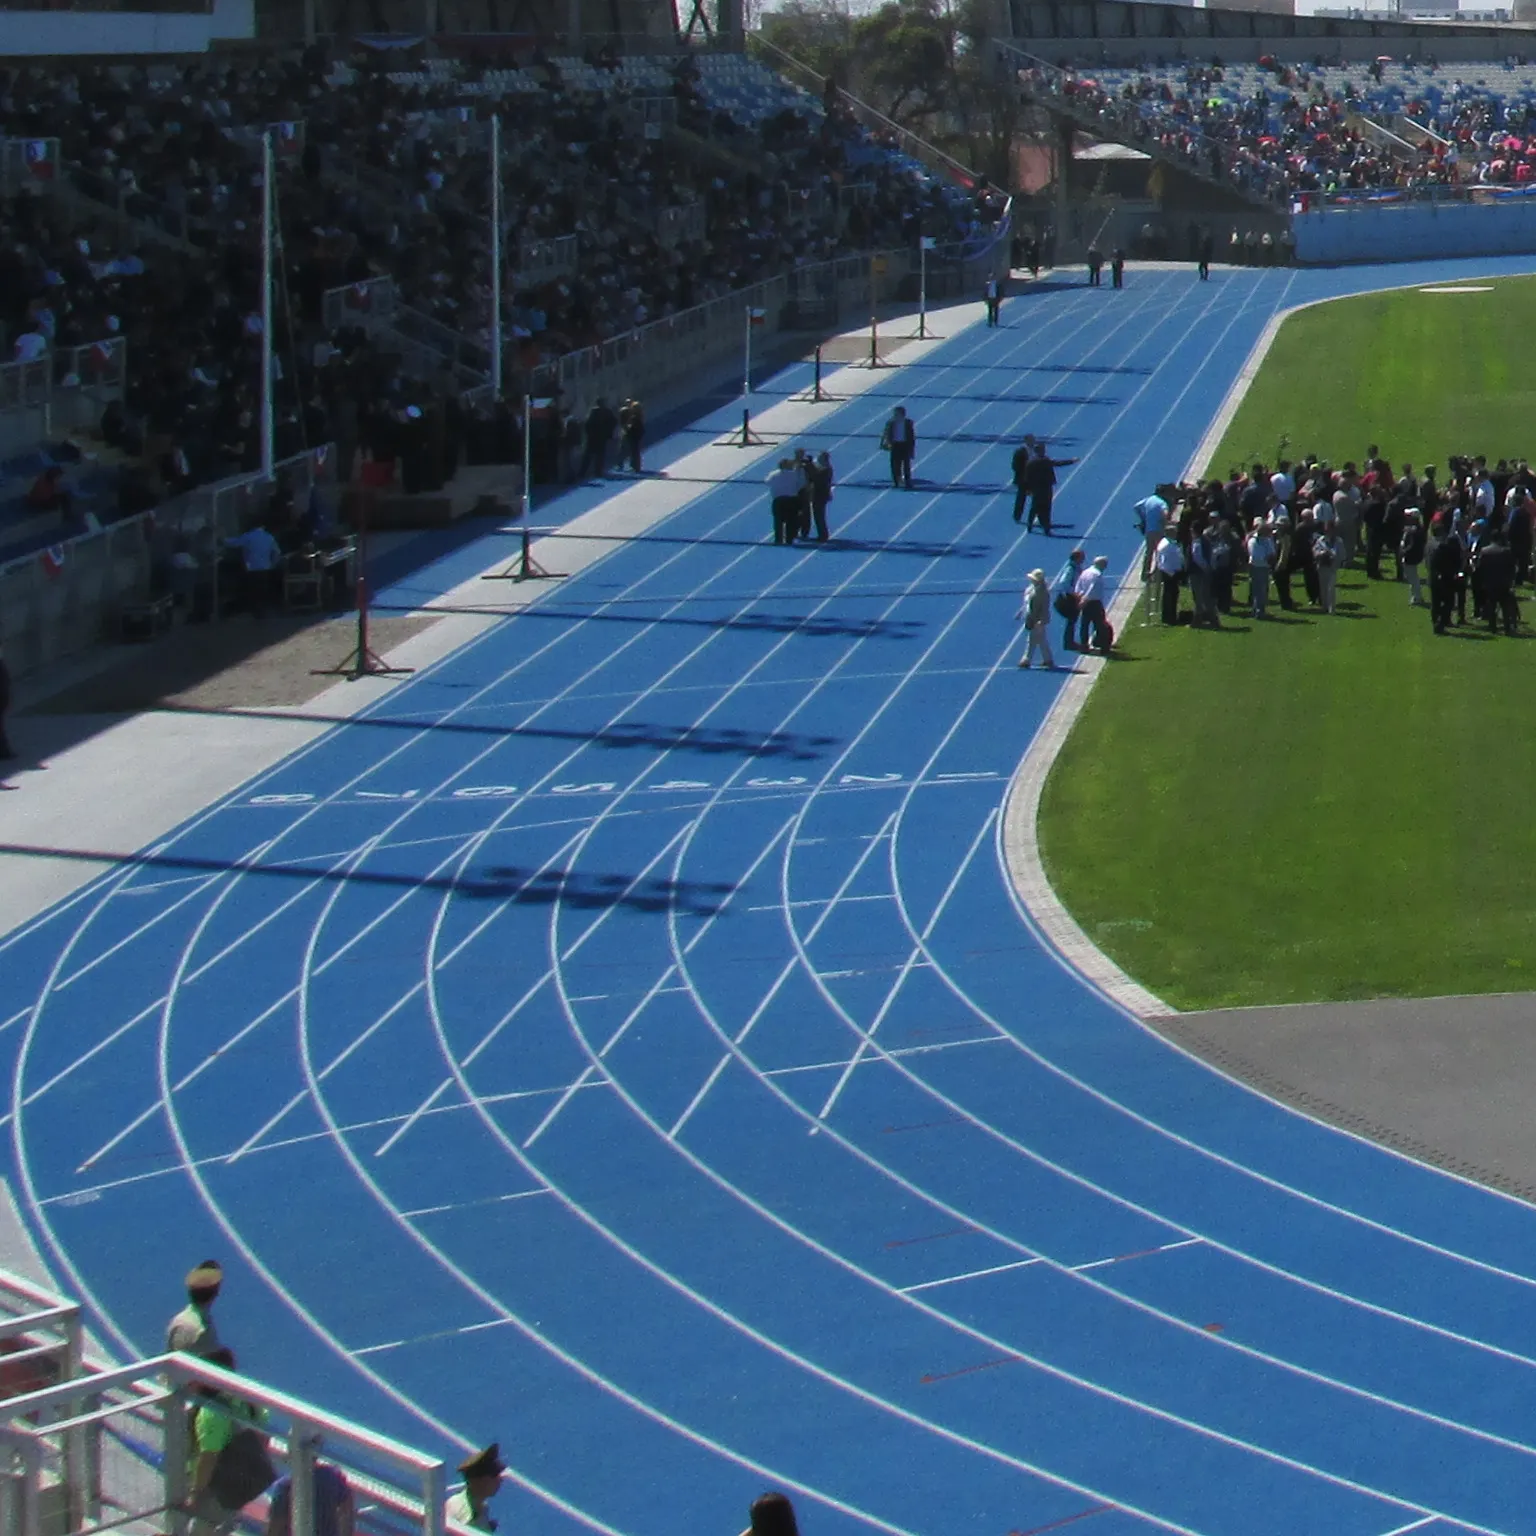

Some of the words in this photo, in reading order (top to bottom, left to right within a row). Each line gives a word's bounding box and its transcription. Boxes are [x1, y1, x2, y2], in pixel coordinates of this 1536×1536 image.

[747, 775, 808, 787] 3
[840, 773, 903, 784] 2
[452, 785, 517, 797] 6
[552, 781, 617, 793] 5
[250, 793, 315, 804] 8
[355, 789, 420, 800] 7
